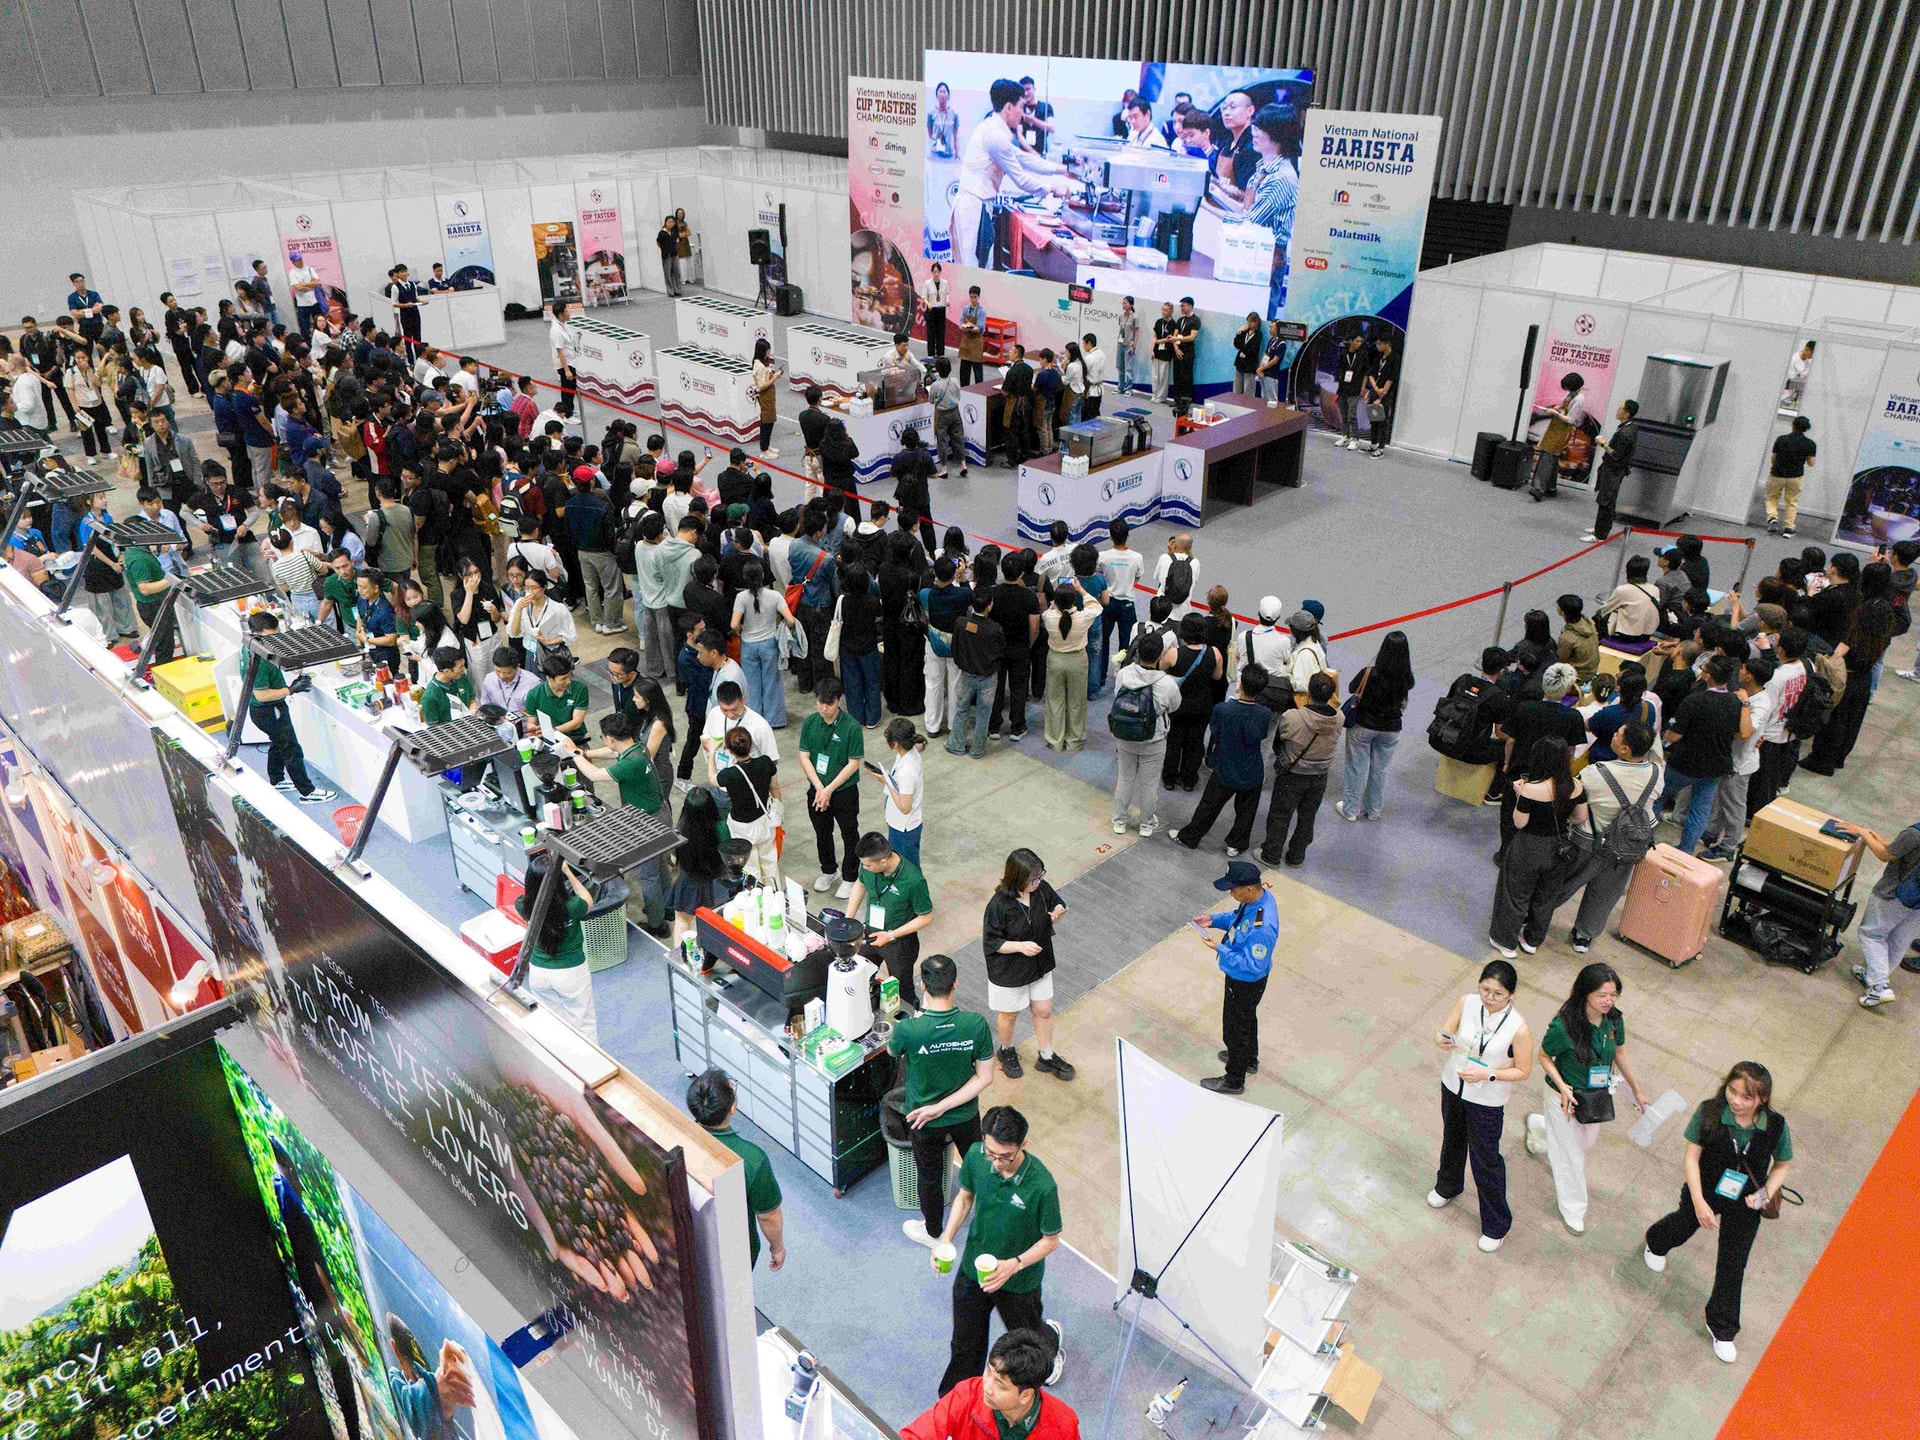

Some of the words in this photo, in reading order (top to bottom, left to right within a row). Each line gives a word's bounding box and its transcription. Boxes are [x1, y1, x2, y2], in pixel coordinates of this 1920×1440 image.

[856, 87, 885, 98] Vietnam
[887, 90, 917, 100] National
[856, 98, 873, 111] CUP
[875, 99, 917, 116] TASTERS
[856, 112, 917, 126] CHAMPIONSHIP
[1324, 124, 1368, 138] Vietnam
[1371, 128, 1419, 142] National
[885, 141, 907, 155] ditting
[1321, 136, 1415, 163] BARISTA
[1320, 157, 1413, 176] CHAMPIONSHIP
[594, 211, 616, 219] TASTERS
[759, 213, 779, 223] BARIST
[447, 225, 482, 235] BARISTA
[1329, 227, 1382, 243] Dalatmilk
[302, 240, 332, 249] TASTERS
[1371, 268, 1406, 279] Scotsman
[1083, 307, 1119, 320] EXPORUM
[1551, 346, 1568, 356] CUP
[1570, 349, 1611, 363] TASTERS
[1553, 340, 1582, 349] Vietnam
[1583, 344, 1613, 354] National
[1549, 355, 1609, 370] CHAMPIONSHIP
[1021, 468, 1027, 477] 2
[1117, 475, 1143, 490] BARISTA
[1161, 509, 1180, 517] Barista
[1788, 854, 1795, 862] la
[1796, 859, 1830, 877] marzocco
[321, 951, 355, 990] PEOPLE
[368, 994, 427, 1056] TECHNOLOGY
[446, 1066, 506, 1129] COMMUNITY
[929, 1040, 974, 1050] AUTOSHOP
[312, 963, 376, 1045] FROM
[386, 1031, 516, 1179] VIETNAM
[287, 975, 318, 1024] TO
[328, 1015, 415, 1120] COFFEE
[425, 1107, 529, 1231] LOVERS
[547, 1286, 597, 1351] TINH
[607, 1348, 662, 1418] THẦN
[67, 1371, 116, 1414] it
[141, 1315, 223, 1369] all,
[582, 1345, 633, 1410] VÙNG
